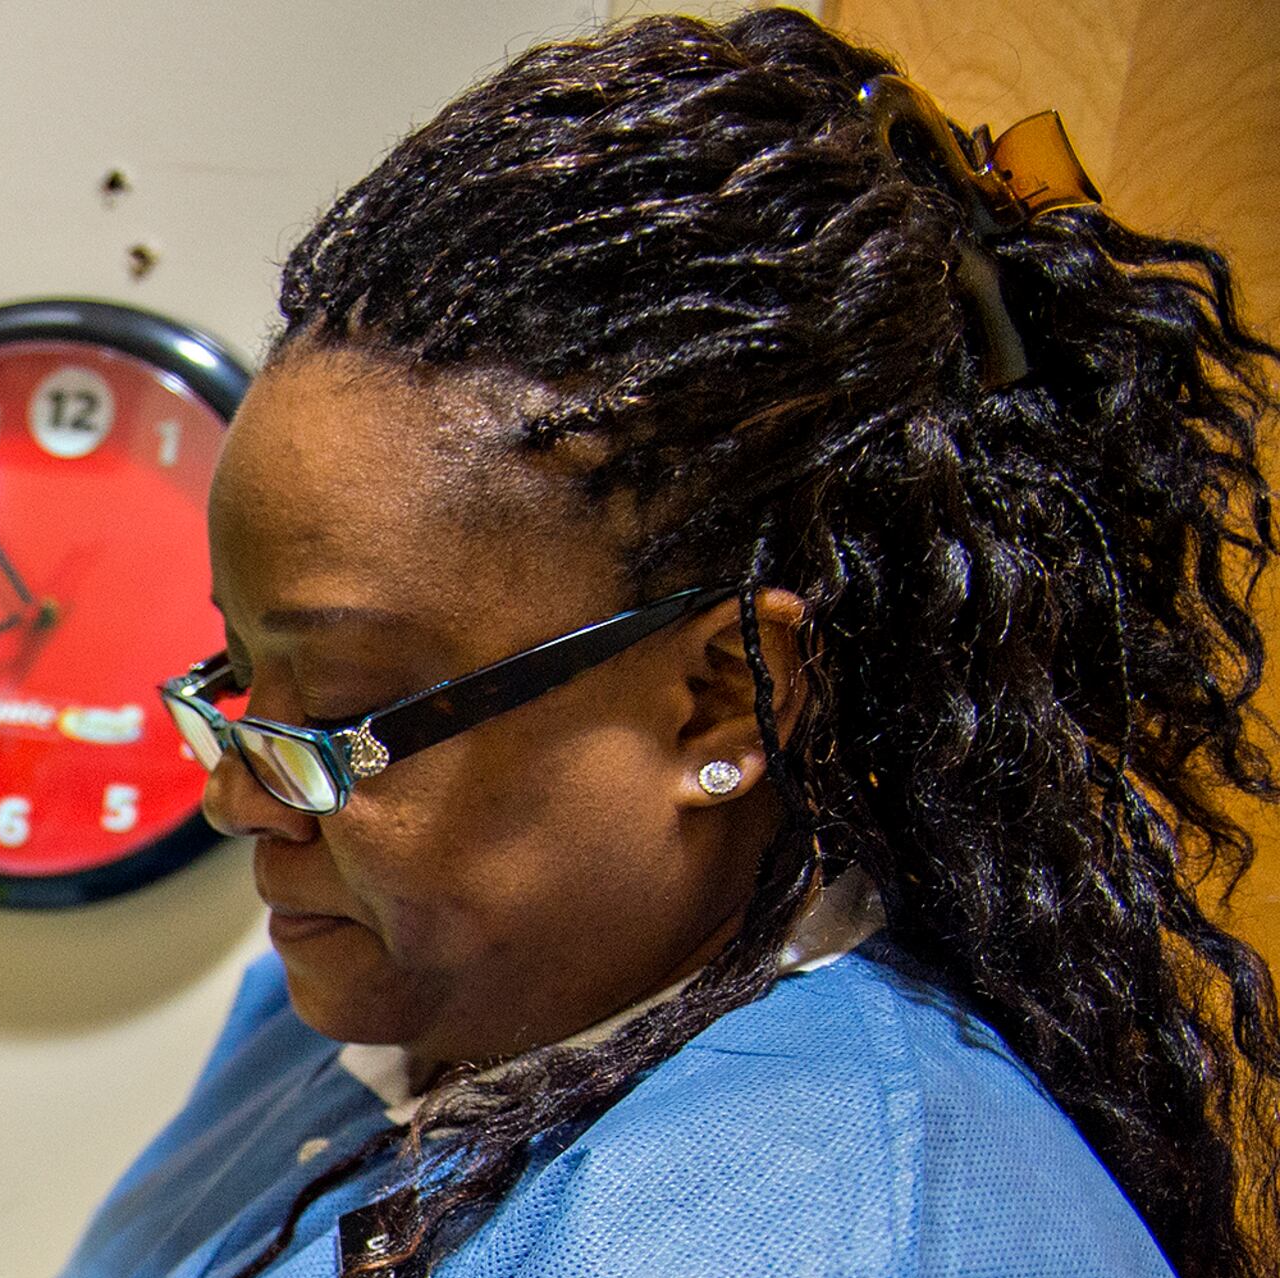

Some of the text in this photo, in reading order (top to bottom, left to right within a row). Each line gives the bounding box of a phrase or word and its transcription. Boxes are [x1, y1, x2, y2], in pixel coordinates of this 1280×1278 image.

[47, 389, 100, 432] 12
[156, 419, 181, 467] 1
[100, 783, 138, 833] 5
